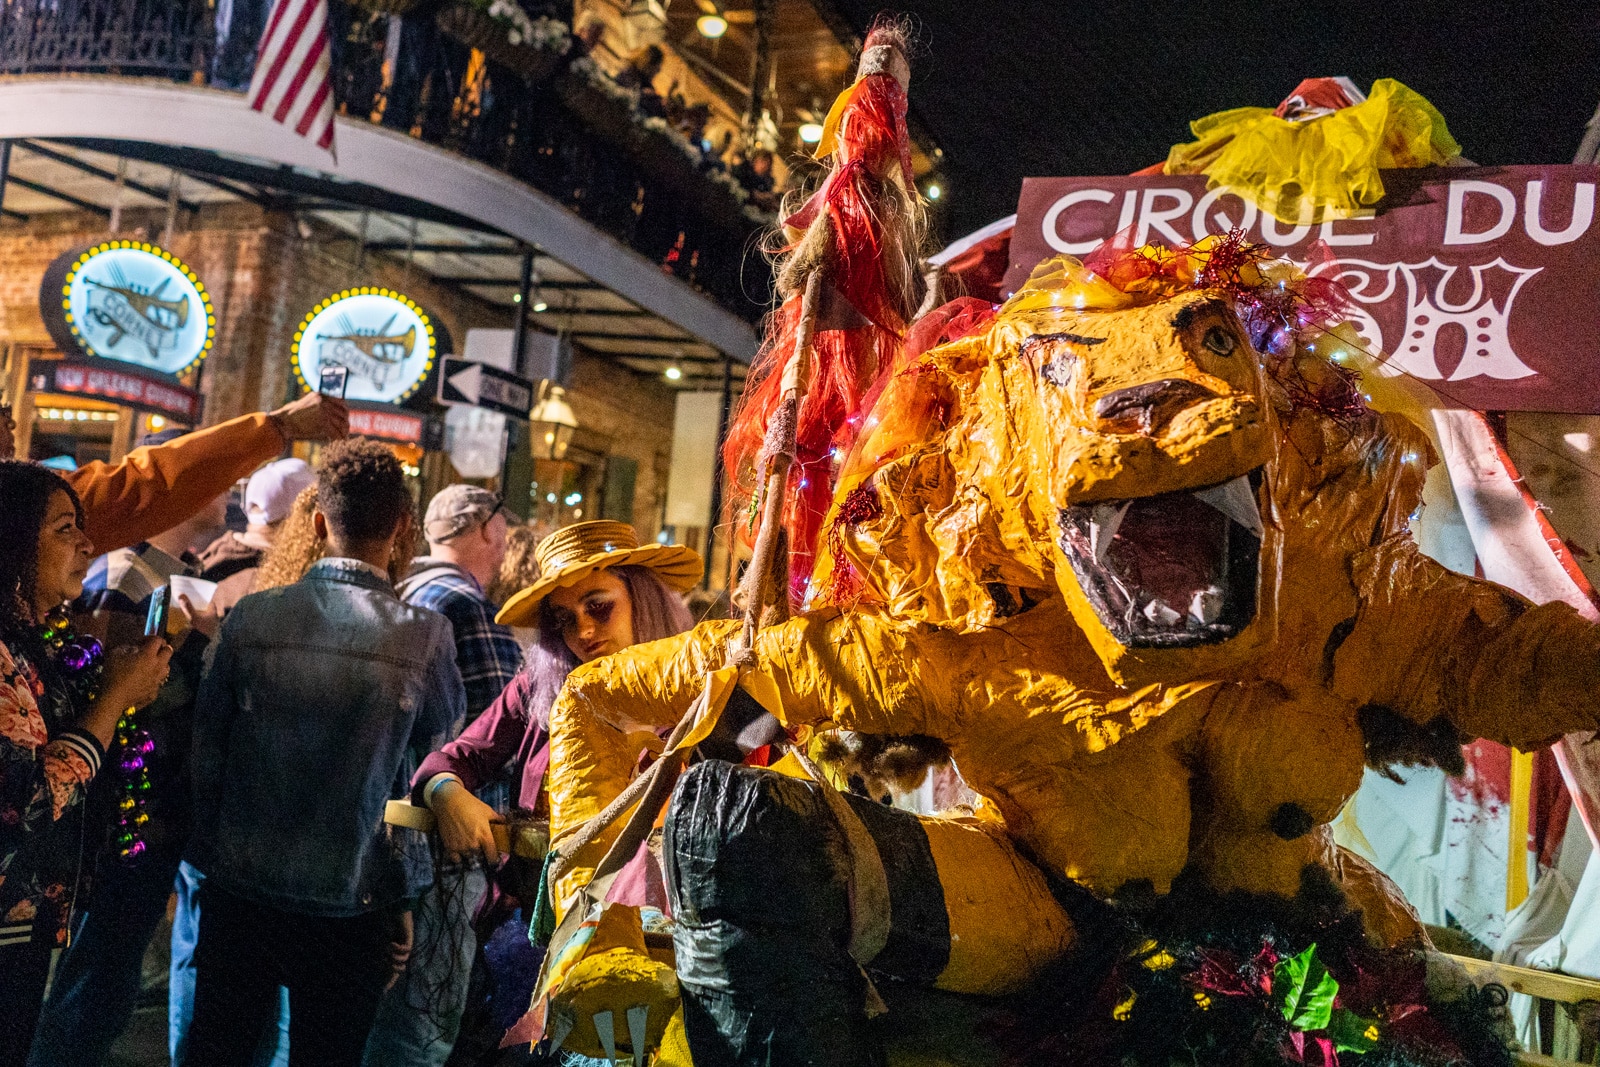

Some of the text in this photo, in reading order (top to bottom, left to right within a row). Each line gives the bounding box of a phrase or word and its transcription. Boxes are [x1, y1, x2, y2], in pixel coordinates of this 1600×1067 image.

[1042, 179, 1596, 254] CIRQUE DU
[104, 292, 164, 346] CORNET
[334, 343, 392, 382] CORNET
